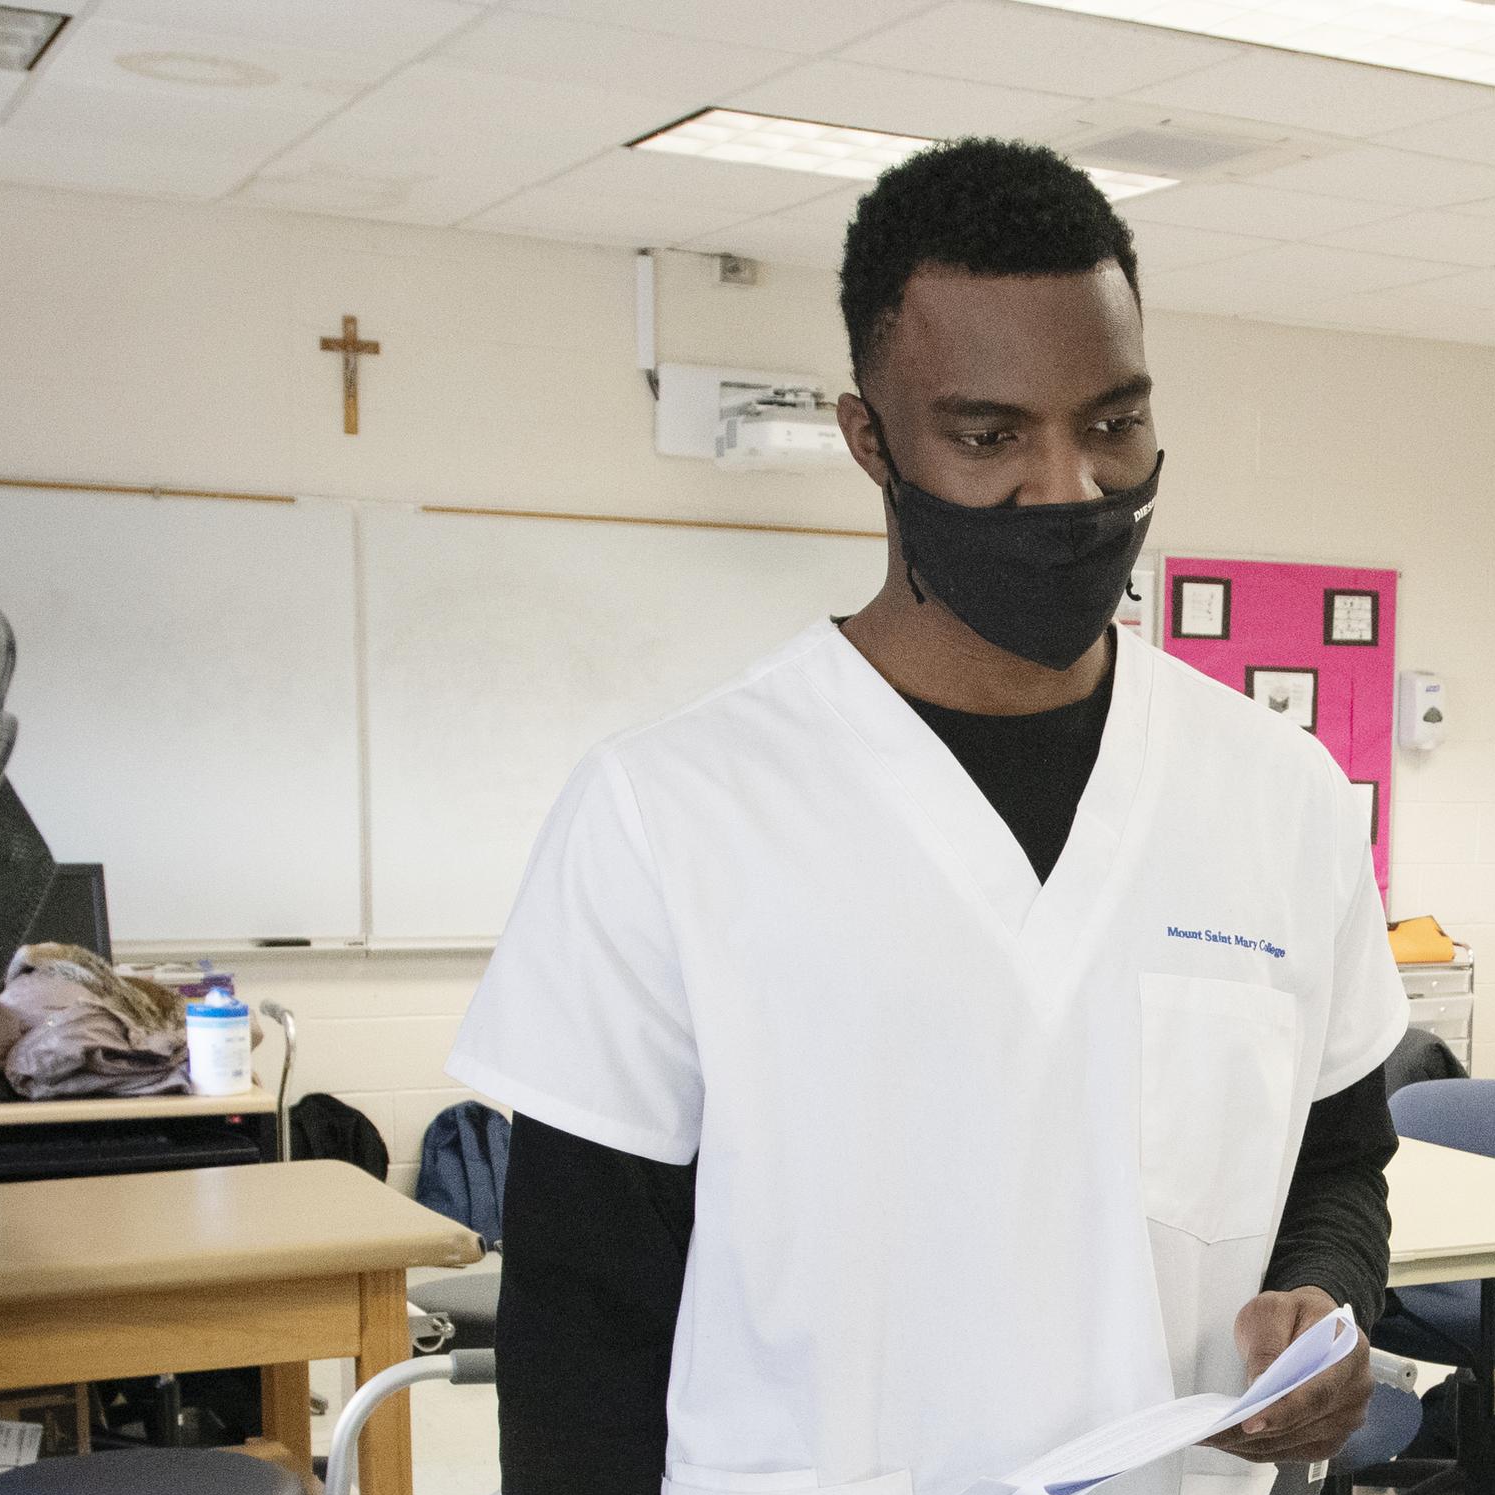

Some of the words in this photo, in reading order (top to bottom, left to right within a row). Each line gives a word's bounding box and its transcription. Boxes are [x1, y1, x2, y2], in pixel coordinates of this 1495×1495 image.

[1167, 926, 1203, 941] Mount
[1204, 929, 1232, 945] Saint
[1234, 935, 1257, 951] Mary
